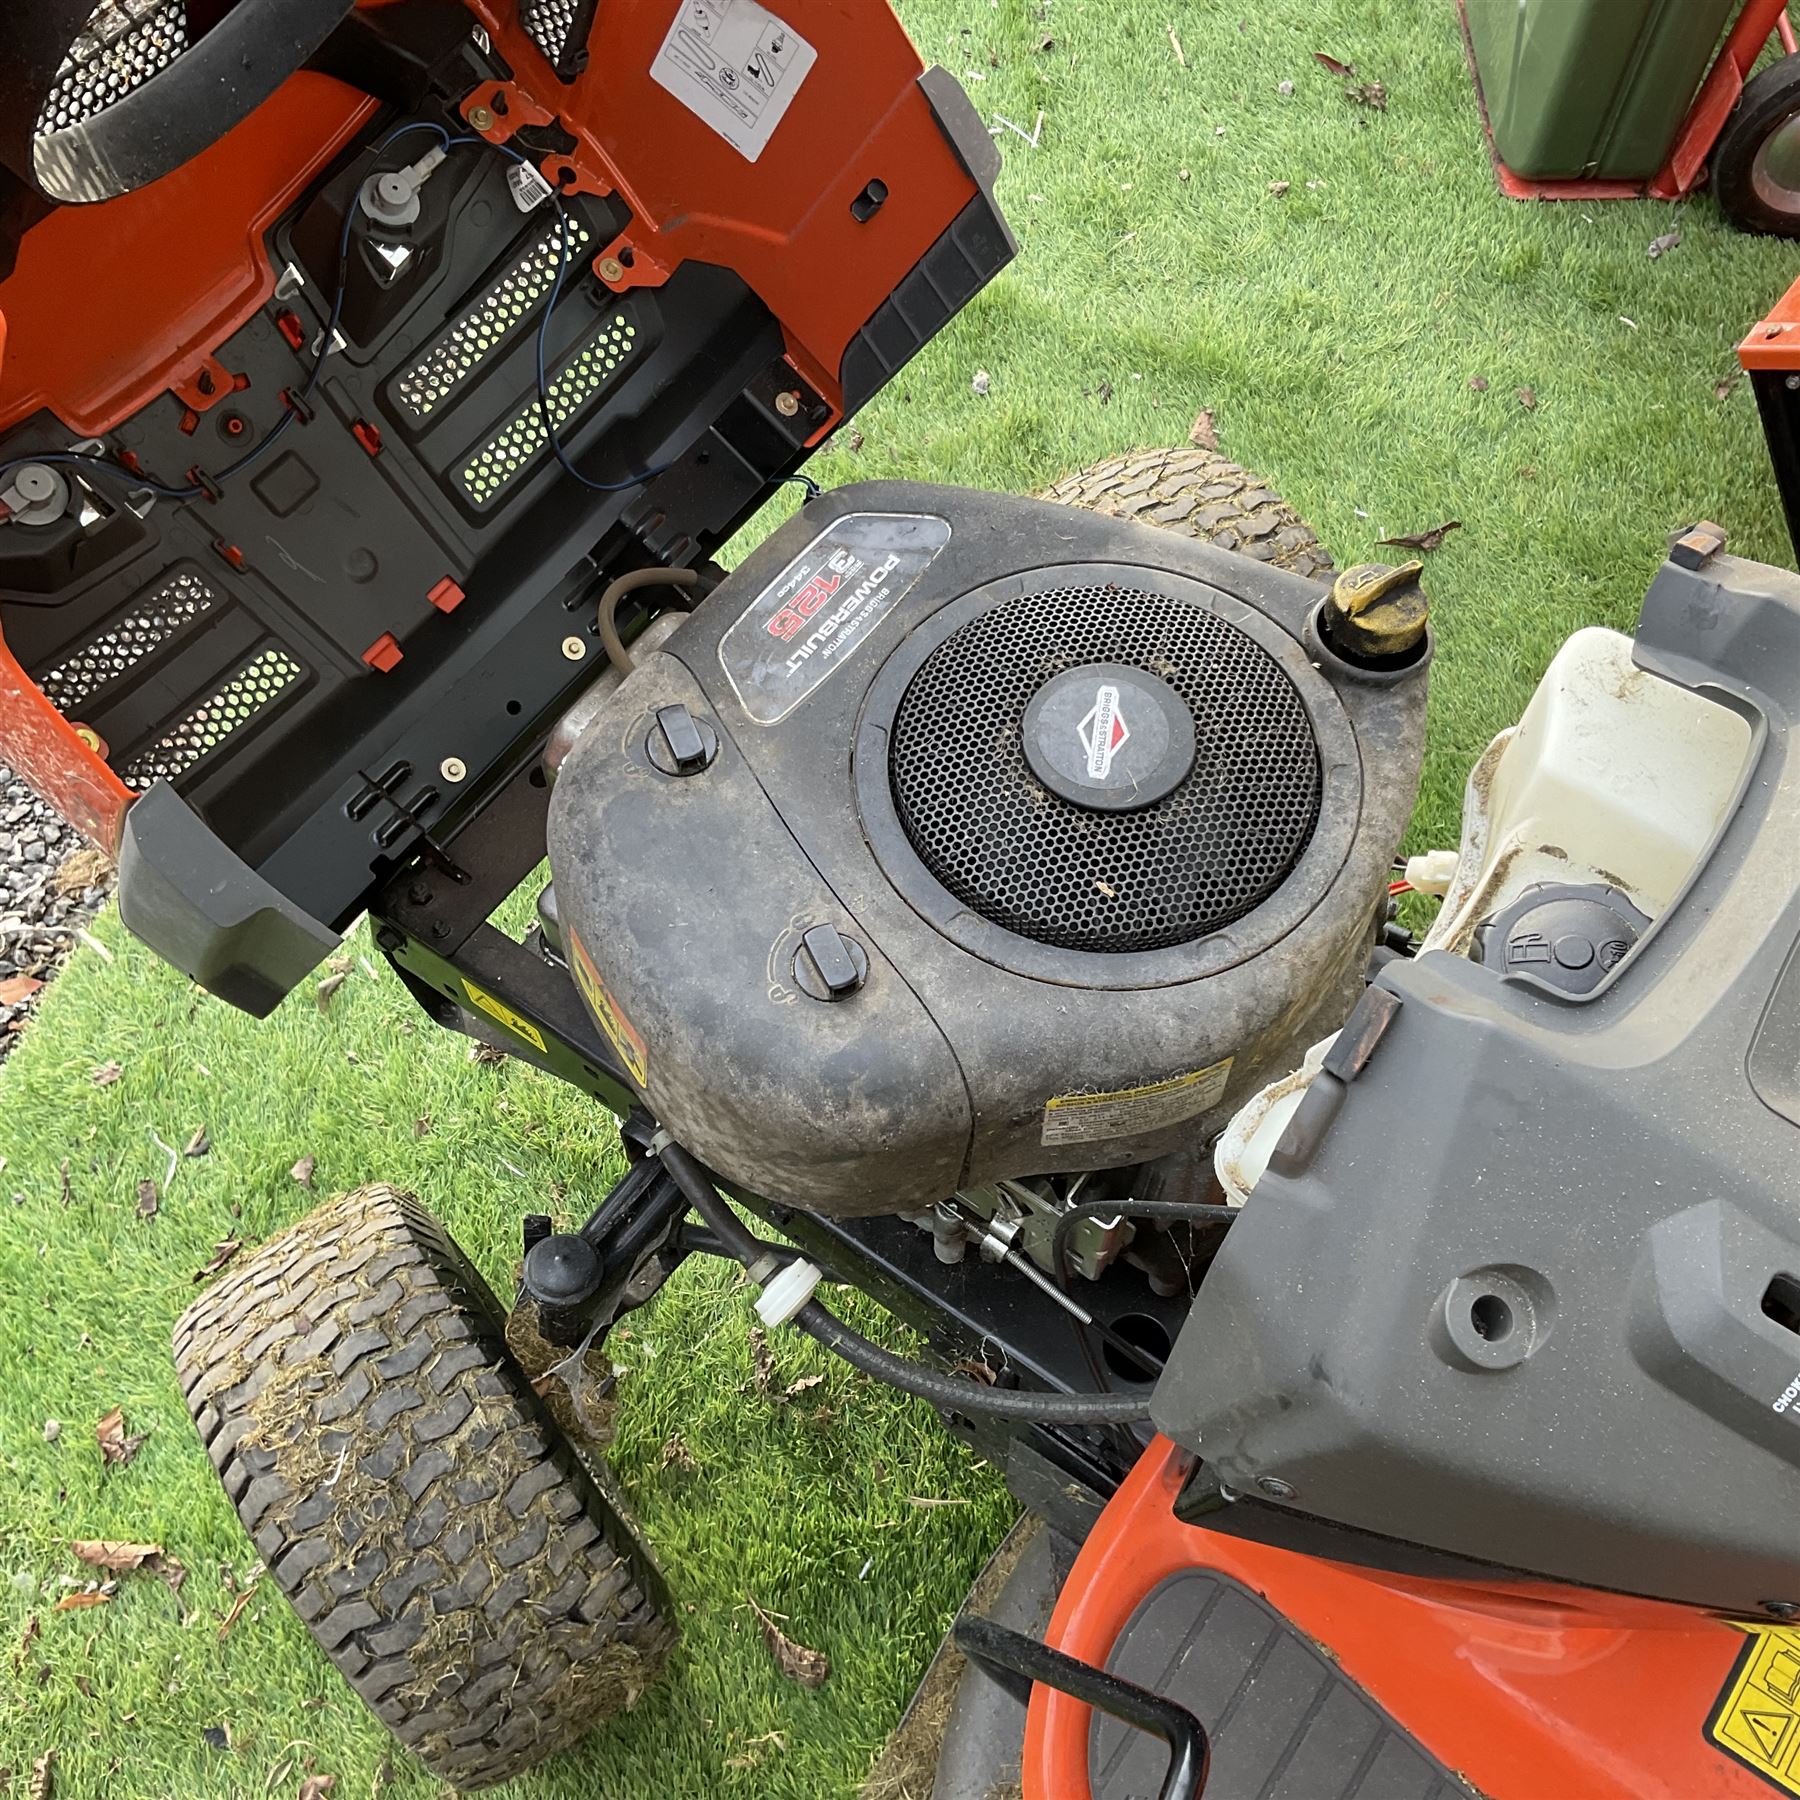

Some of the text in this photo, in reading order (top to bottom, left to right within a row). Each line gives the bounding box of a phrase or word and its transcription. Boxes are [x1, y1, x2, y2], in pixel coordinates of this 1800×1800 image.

[767, 574, 841, 641] 125
[785, 553, 901, 675] POWERBUILT
[1772, 1373, 1800, 1413] CHOK
